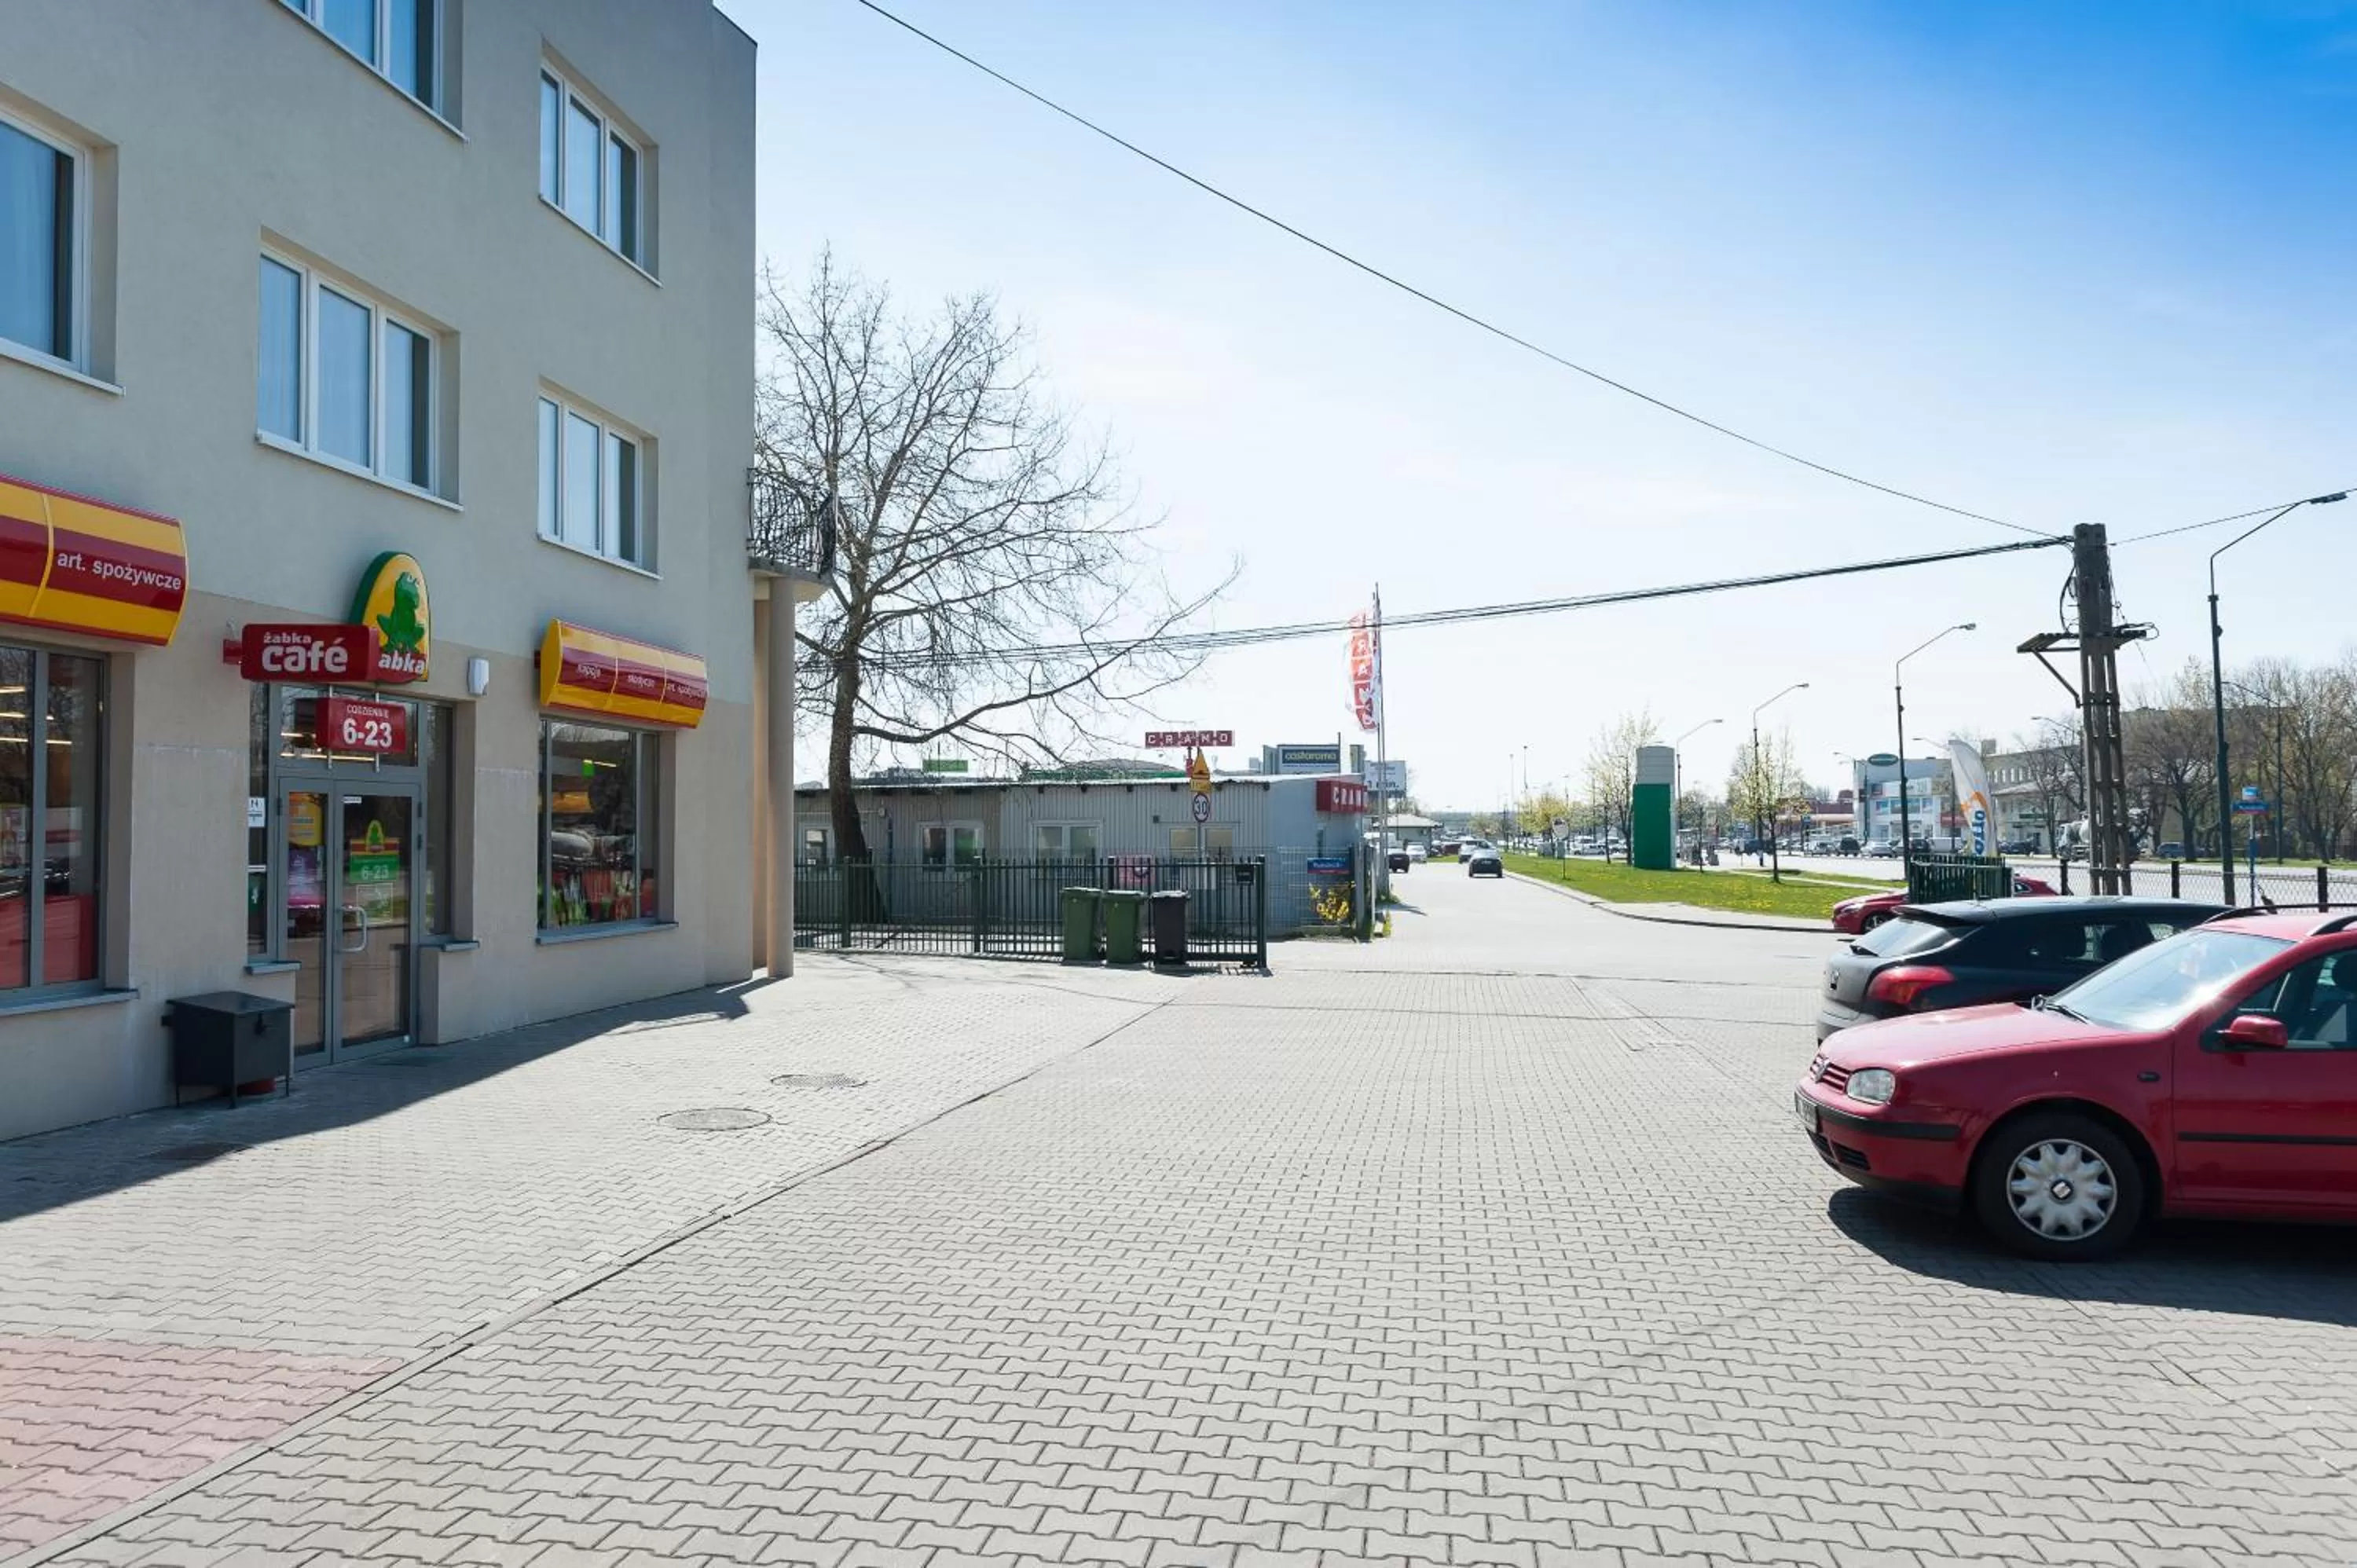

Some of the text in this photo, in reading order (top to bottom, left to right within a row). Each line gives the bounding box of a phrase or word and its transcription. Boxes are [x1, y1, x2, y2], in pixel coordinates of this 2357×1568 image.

[57, 552, 181, 589] art. spożywcze
[263, 632, 312, 643] żabka
[262, 639, 348, 672] café
[378, 650, 425, 675] abka
[343, 718, 393, 748] 6-23
[1148, 734, 1228, 744] CRANO
[1193, 799, 1208, 815] 30
[361, 865, 389, 881] 6-23
